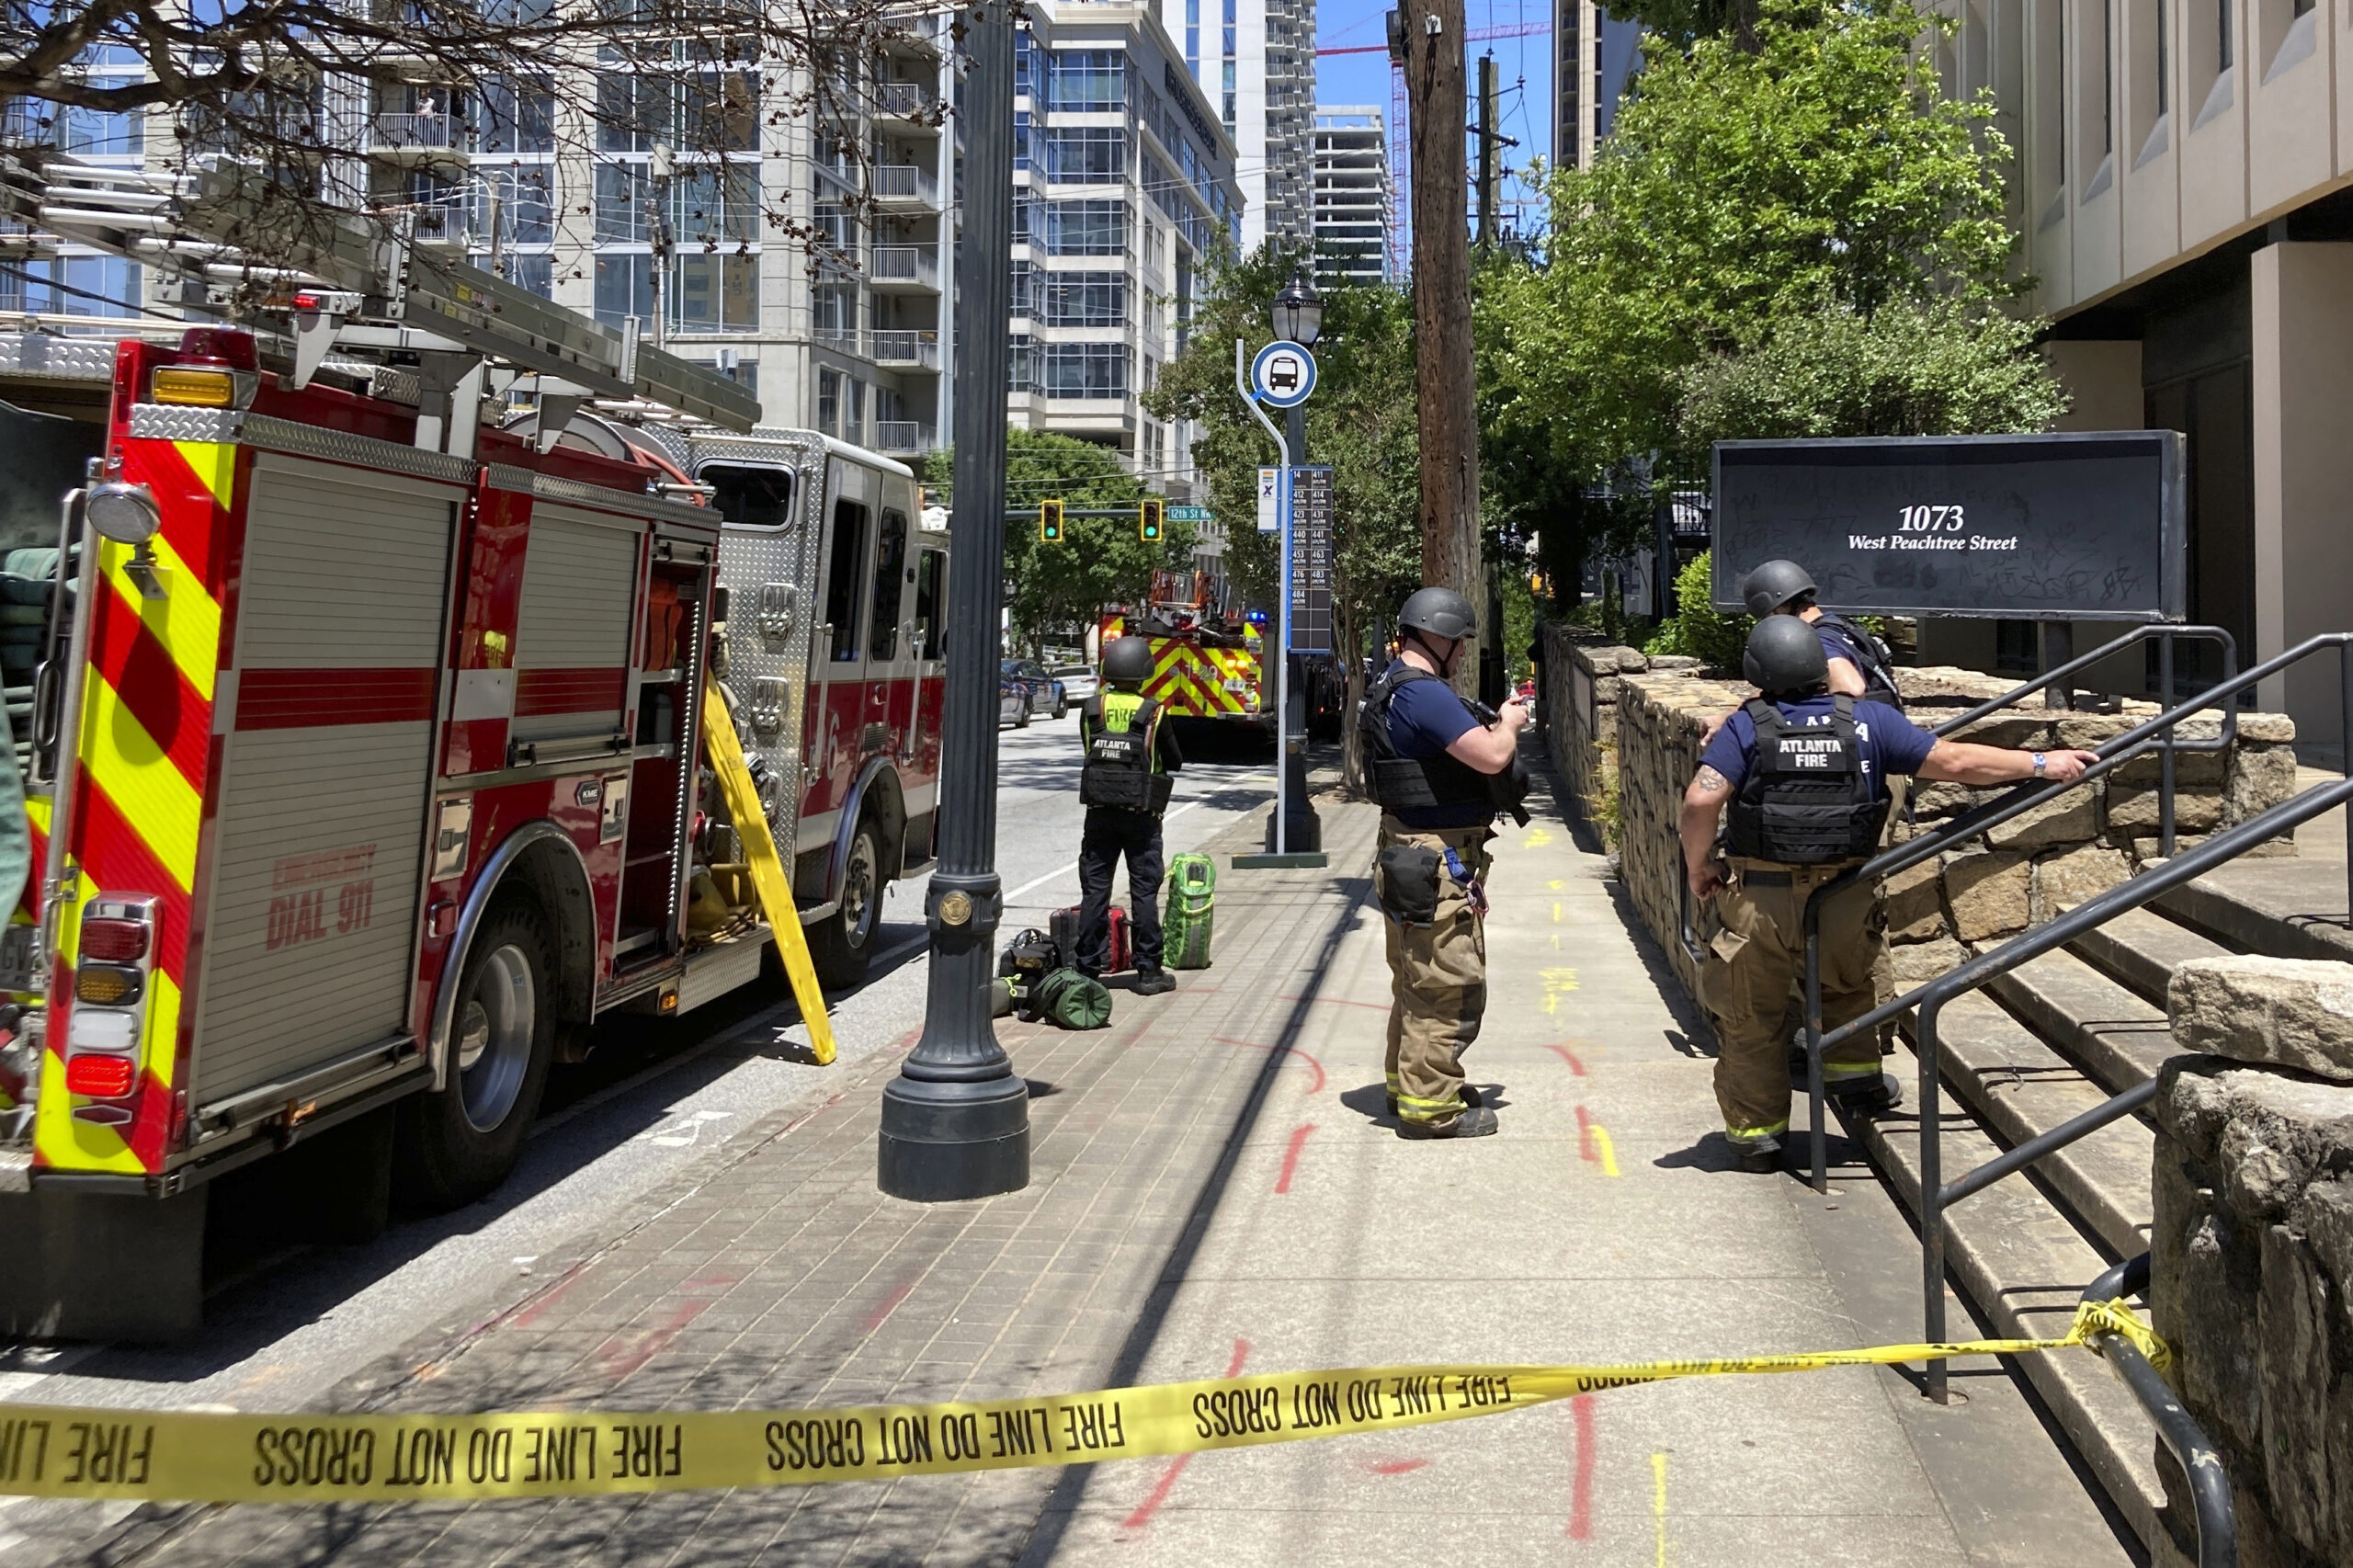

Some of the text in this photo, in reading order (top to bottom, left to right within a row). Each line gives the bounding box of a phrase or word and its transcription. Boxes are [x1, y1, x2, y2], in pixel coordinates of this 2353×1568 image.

[1171, 508, 1187, 518] 12th
[1189, 508, 1198, 518] St
[1898, 505, 1964, 531] 1073
[1848, 535, 2018, 550] West Peachtree Street
[1095, 739, 1131, 750] ATLANTA
[1101, 749, 1121, 758] FIRE
[1779, 740, 1842, 753] ATLANTA
[1795, 754, 1827, 767] FIRE
[583, 790, 597, 798] KME
[273, 845, 377, 892] EMERGENCY
[267, 880, 374, 950] DIAL 911
[1193, 1375, 1513, 1438] FIRE LINE DO NOT CROSS
[766, 1401, 1125, 1471] FIRE LINE DO NOT CROSS
[0, 1419, 154, 1484] FIRE LIN
[254, 1425, 682, 1486] FIRE LINE DO NOT CROSS
